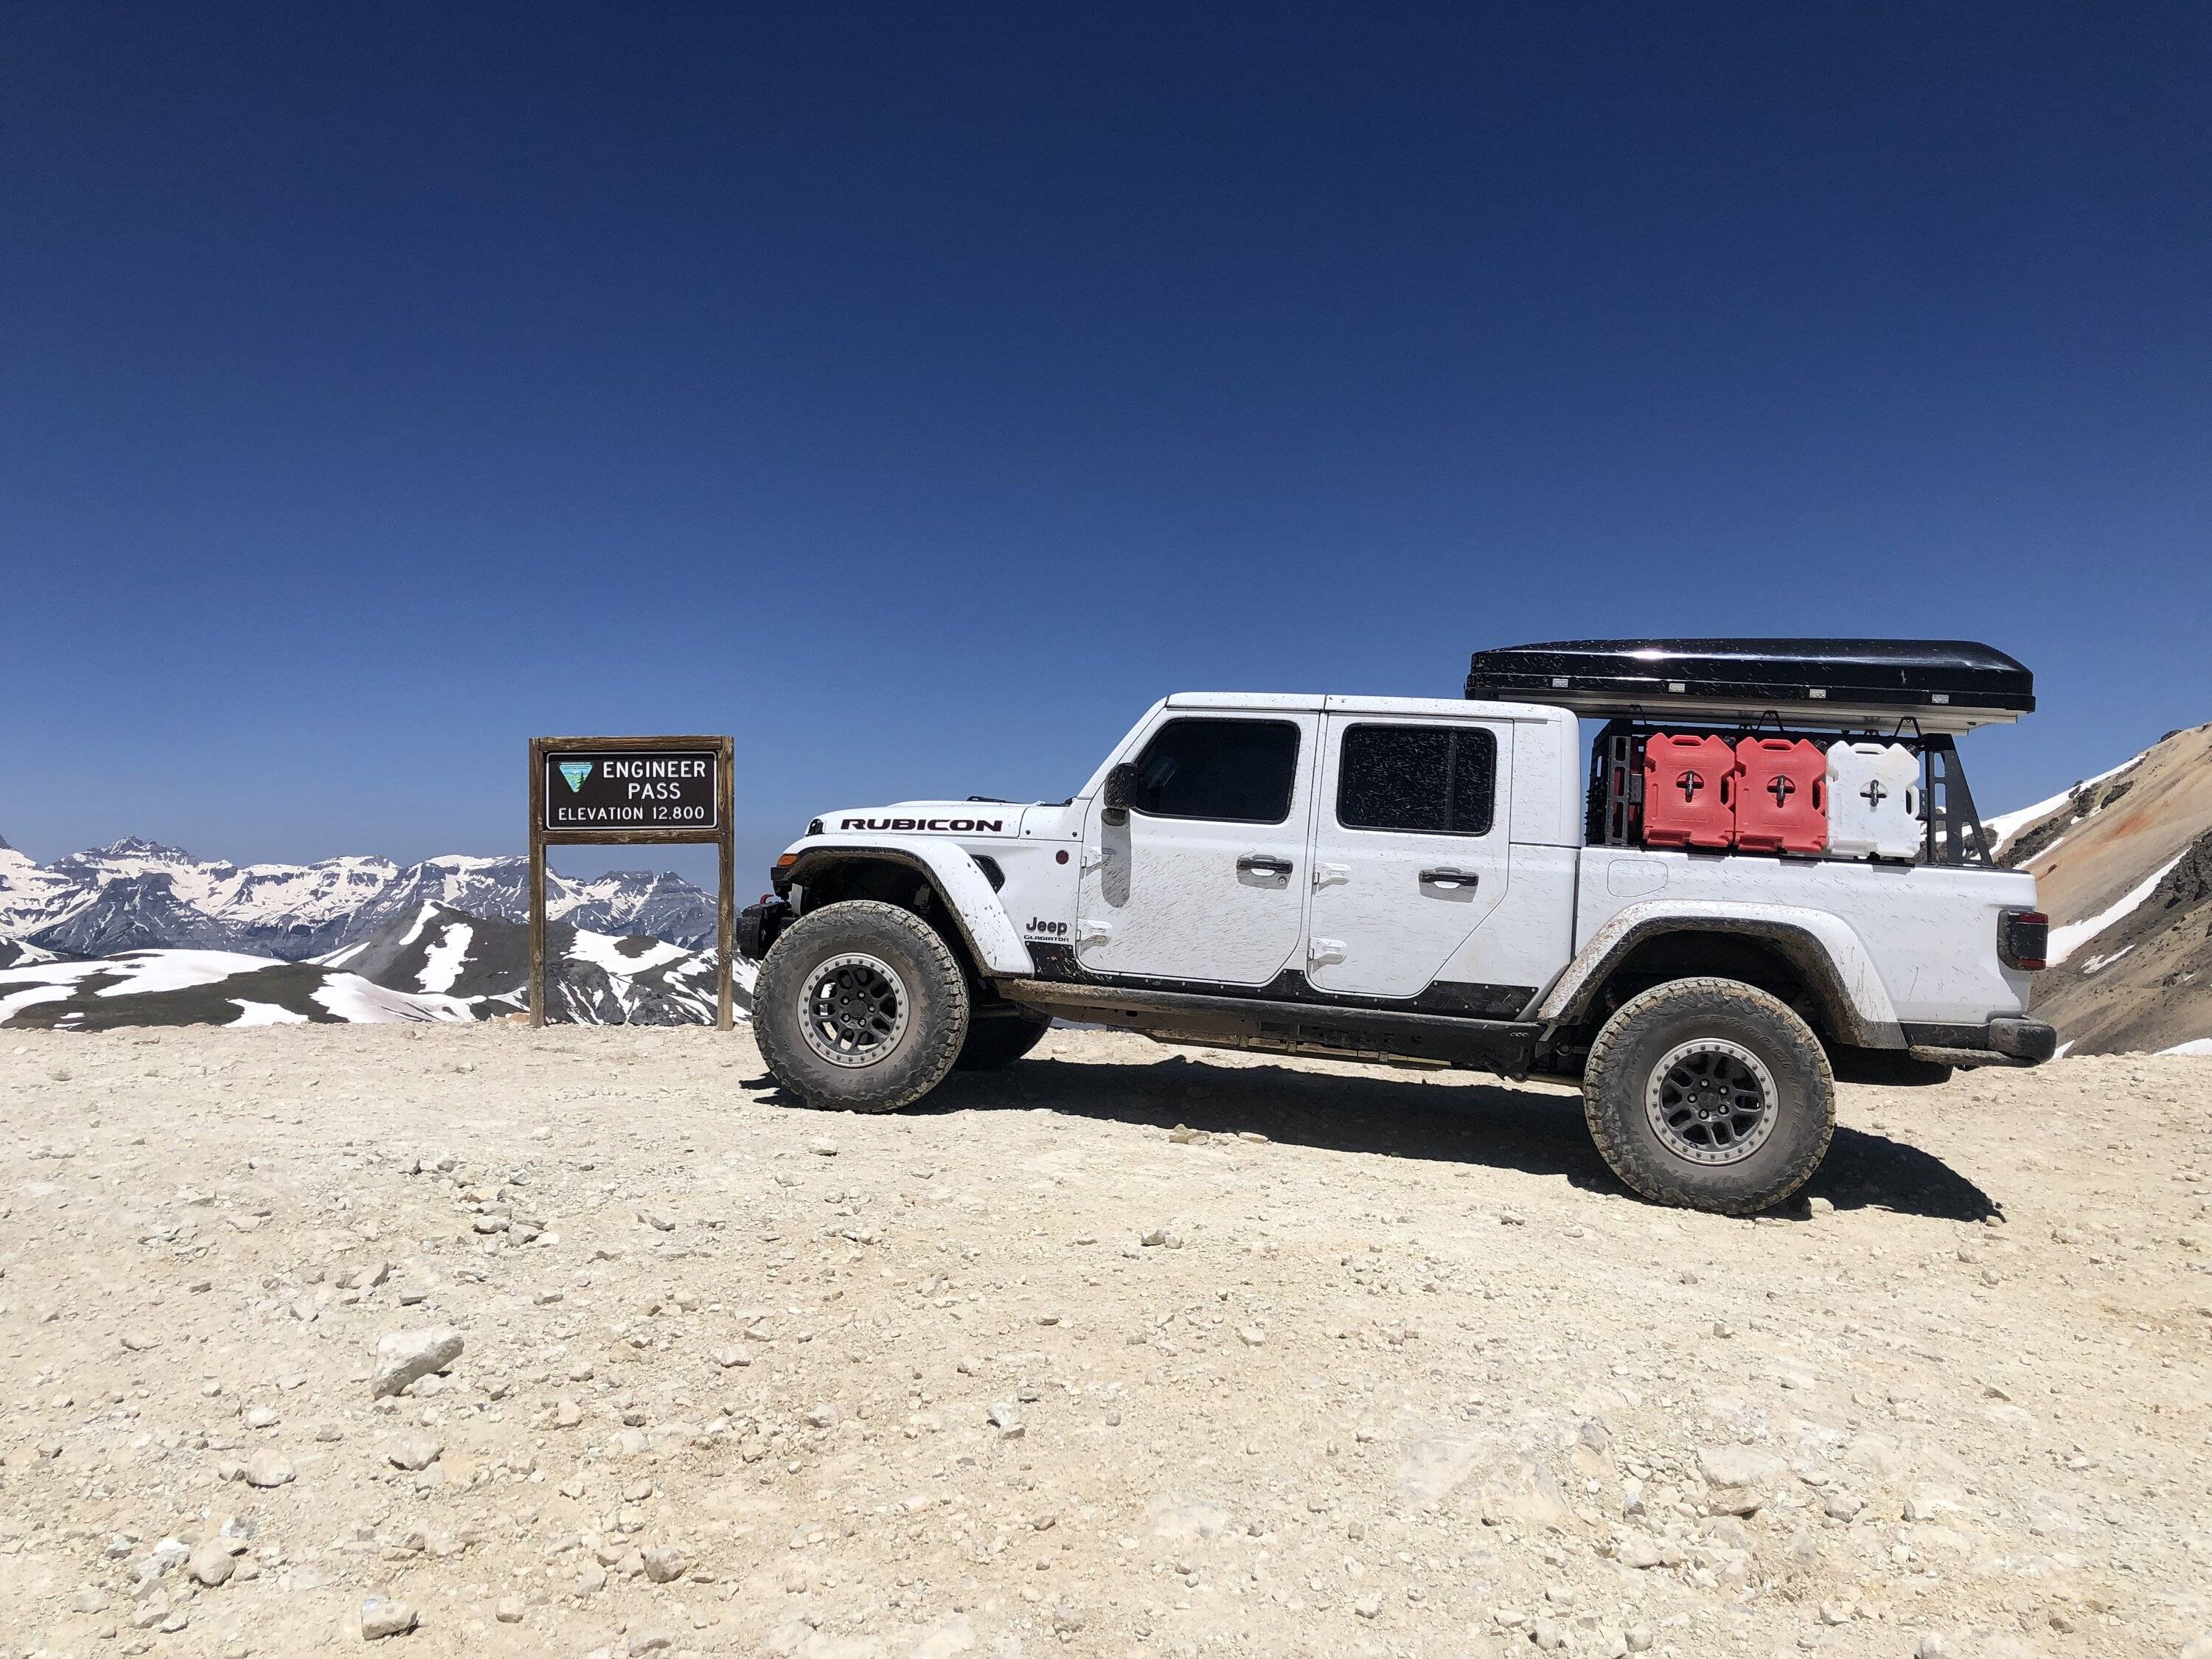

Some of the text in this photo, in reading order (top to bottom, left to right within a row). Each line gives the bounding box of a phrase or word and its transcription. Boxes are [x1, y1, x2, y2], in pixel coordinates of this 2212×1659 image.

[603, 761, 706, 778] ENGINEER
[628, 782, 681, 799] PASS
[558, 807, 643, 821] ELEVATION
[841, 818, 1003, 832] RUBICON
[1026, 917, 1068, 936] Jeep
